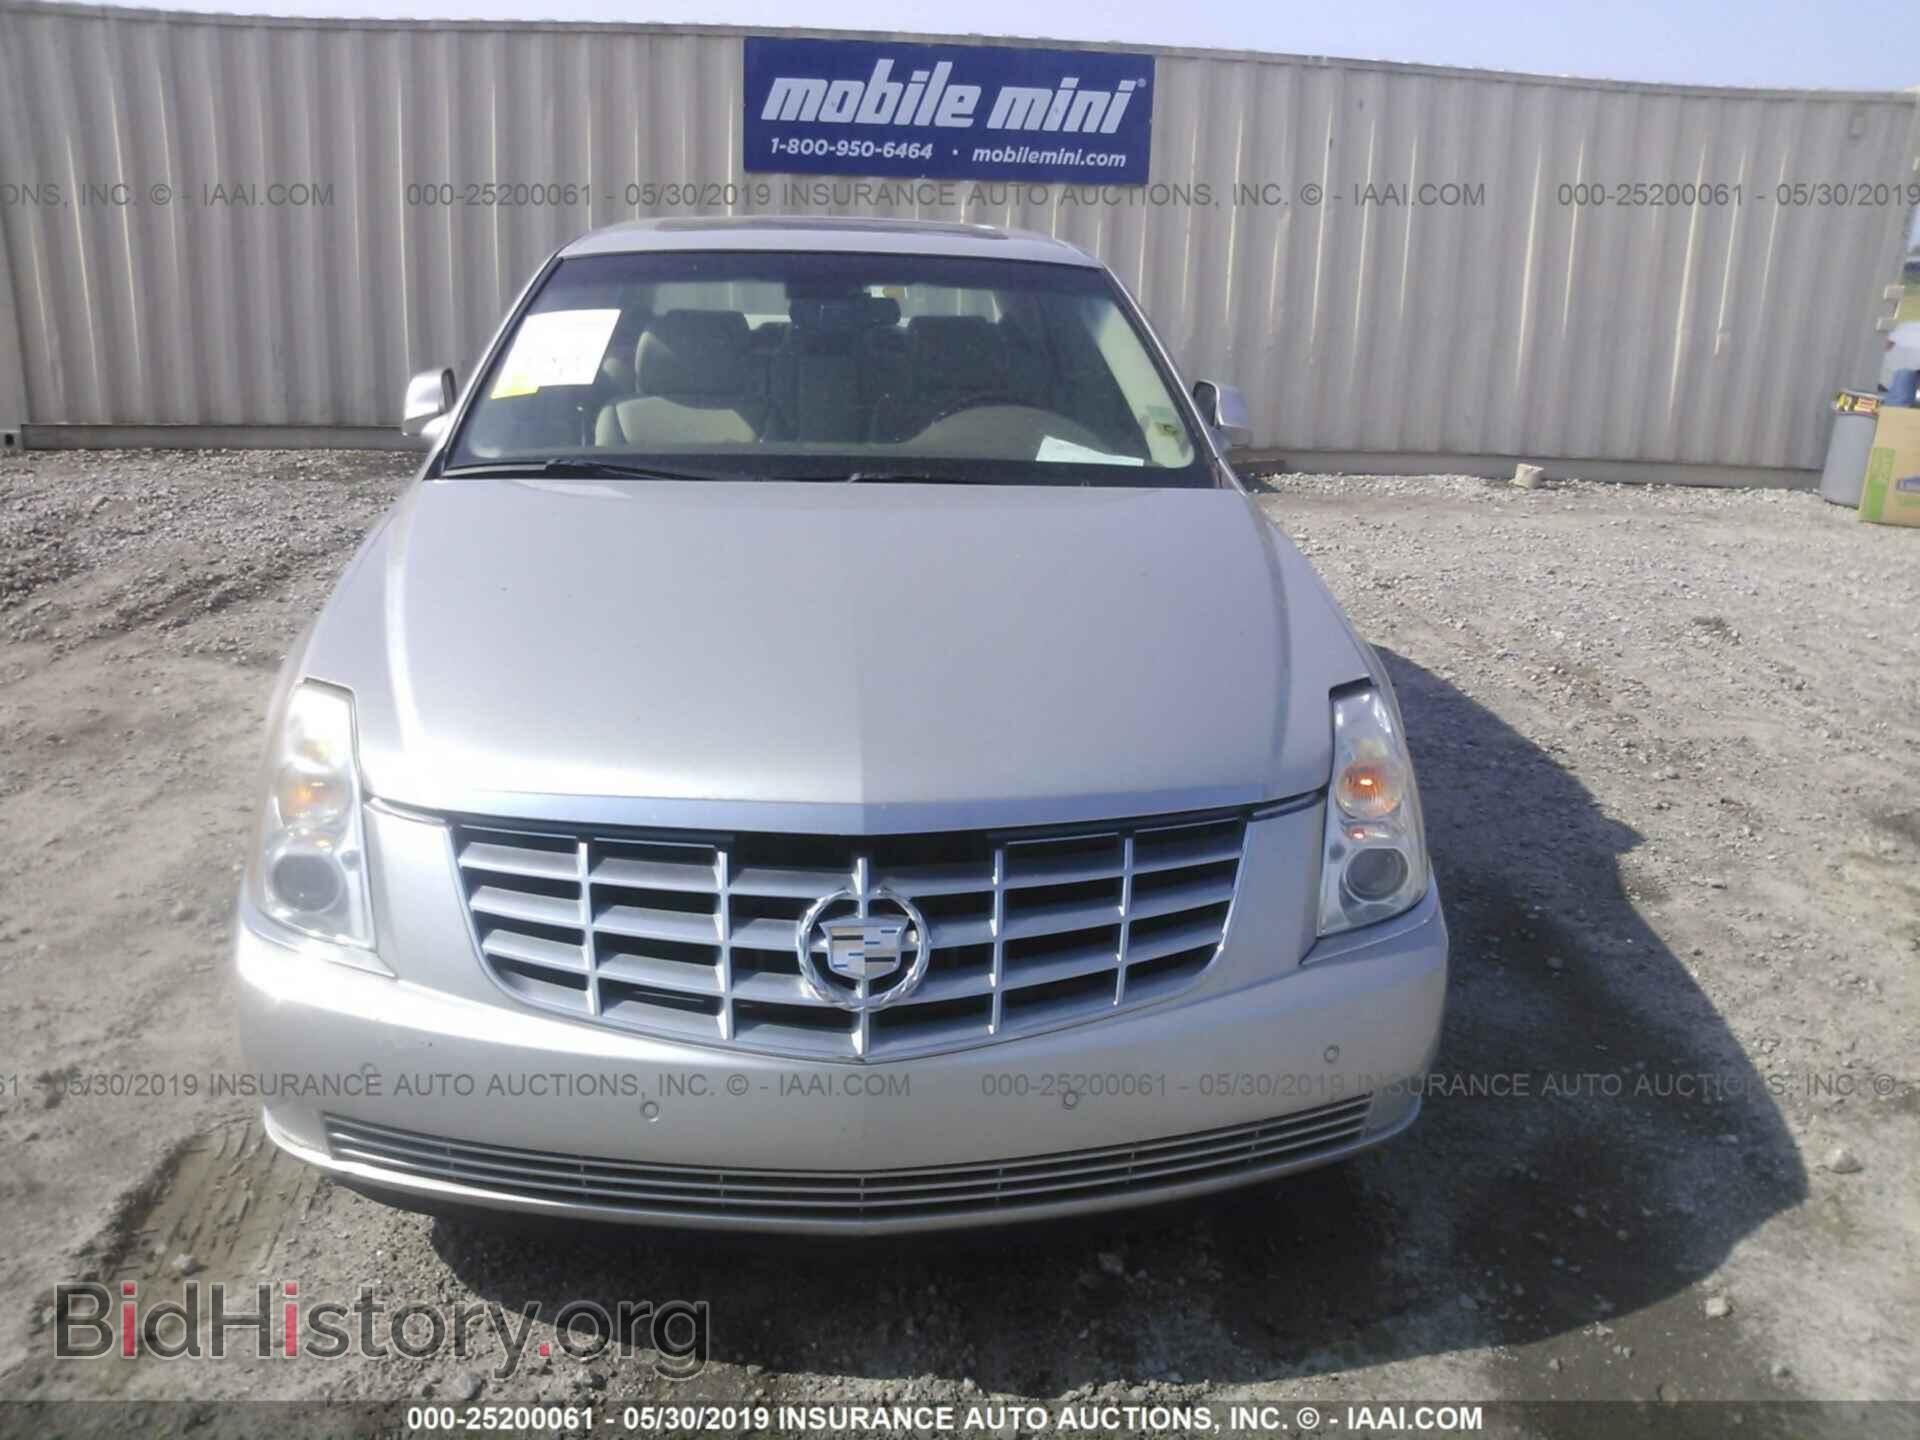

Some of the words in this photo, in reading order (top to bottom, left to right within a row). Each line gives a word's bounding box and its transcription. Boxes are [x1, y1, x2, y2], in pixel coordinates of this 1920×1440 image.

[761, 58, 982, 128] mobile
[987, 77, 1137, 134] mini
[770, 136, 934, 160] 1-800-950-6464
[971, 145, 1127, 168] mobilemini.com
